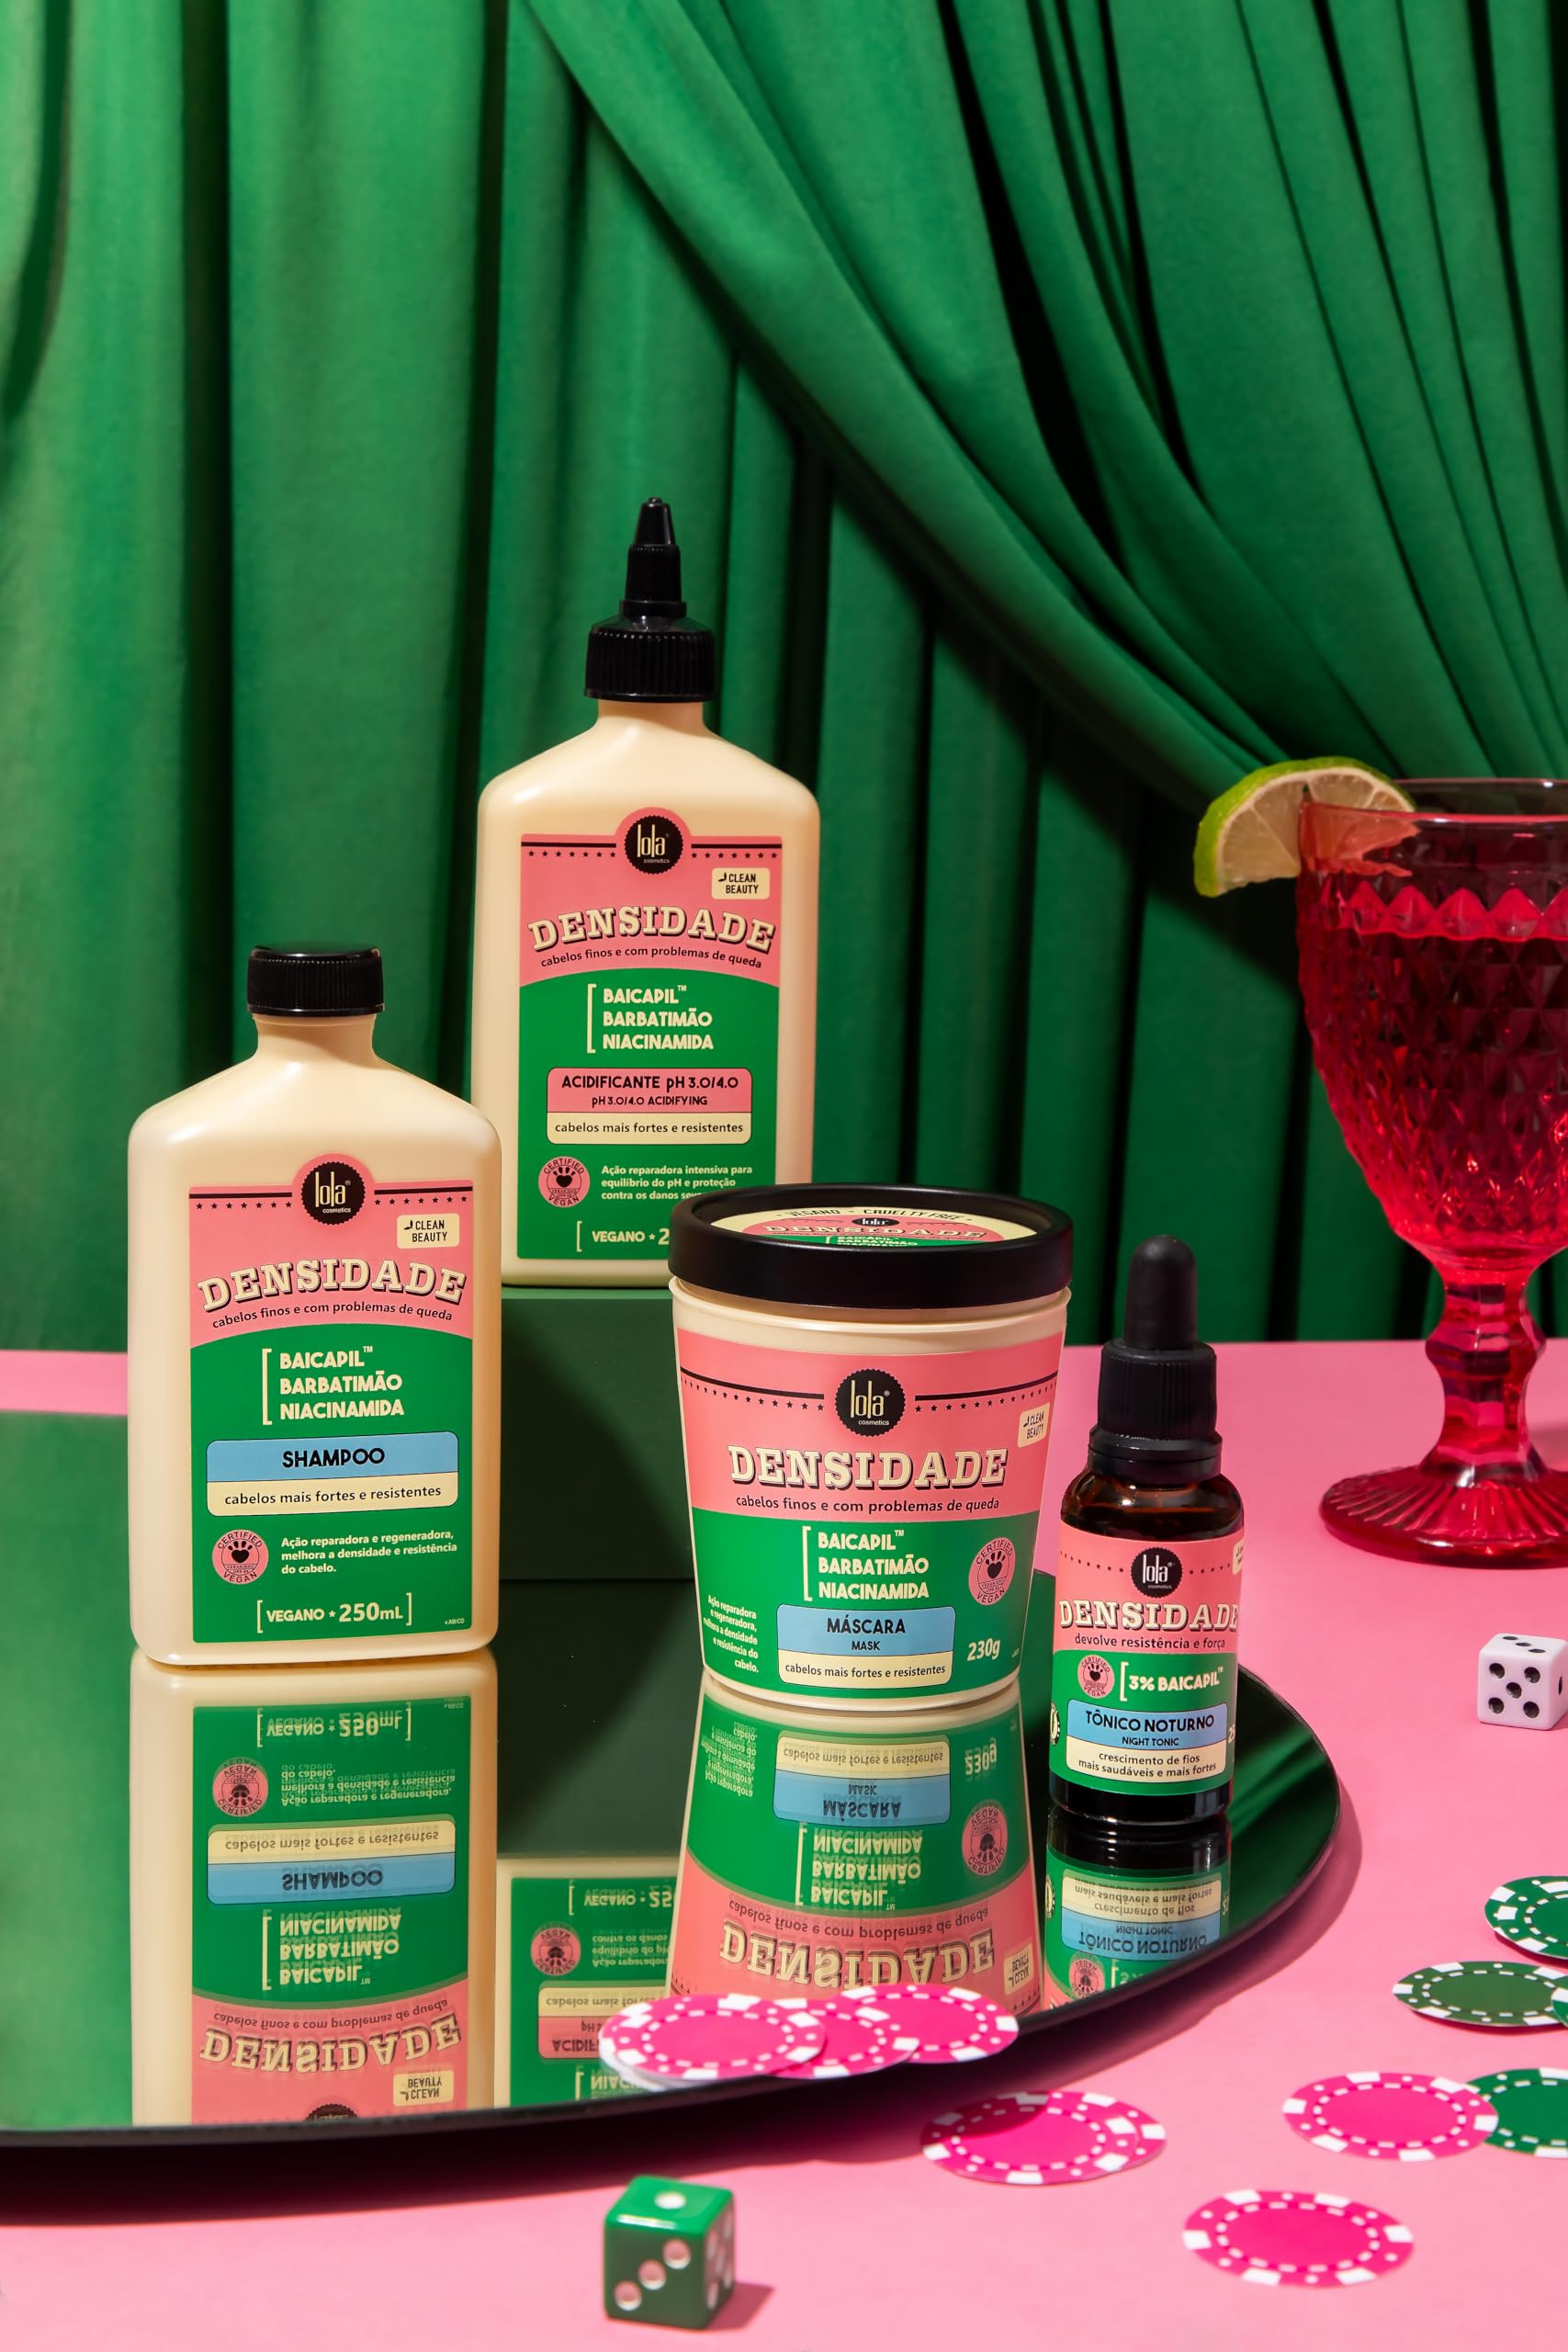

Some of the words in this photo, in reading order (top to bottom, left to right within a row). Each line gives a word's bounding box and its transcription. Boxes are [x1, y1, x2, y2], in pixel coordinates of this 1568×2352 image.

[728, 873, 756, 883] CLEAN
[725, 884, 759, 894] BEAUTY
[527, 905, 776, 955] DENSIDADE
[541, 951, 582, 967] cabelos
[584, 947, 613, 960] finos
[625, 947, 648, 956] com
[650, 945, 709, 960] problemas
[712, 950, 726, 961] de
[728, 954, 762, 969] queda
[603, 1008, 713, 1027] BARBATIMÃO
[603, 1035, 714, 1050] NIACINAMIDA
[561, 1075, 660, 1089] ACIDIFICANTE
[666, 1076, 685, 1093] pH
[688, 1076, 739, 1090] 3.0/4.0
[592, 1096, 605, 1108] pH
[608, 1096, 645, 1106] 3.0/4.0
[648, 1096, 708, 1106] ACIDIFYING
[555, 1121, 599, 1133] cabelos
[603, 1122, 630, 1133] mais
[633, 1122, 669, 1133] fortes
[671, 1125, 679, 1133] e
[682, 1122, 744, 1133] resistentes
[543, 1158, 584, 1175] CERTIFIED
[602, 1165, 626, 1176] Ação
[628, 1166, 682, 1176] reparadora
[685, 1165, 728, 1174] intensiva
[730, 1167, 752, 1177] para
[602, 1178, 649, 1188] equilíbrio
[651, 1178, 665, 1187] do
[667, 1179, 682, 1189] pH
[693, 1177, 736, 1189] proteção
[548, 1195, 580, 1206] VEGAN
[602, 1192, 633, 1200] contra
[649, 1192, 679, 1200] danos
[863, 1209, 926, 1217] CRUELTY
[928, 1212, 964, 1221] FREE
[415, 1218, 445, 1231] CLEAN
[762, 1226, 987, 1238] DENSIDADE
[412, 1231, 447, 1243] BEAUTY
[592, 1230, 645, 1242] VEGANO
[197, 1258, 467, 1313] DENSIDADE
[212, 1310, 257, 1329] cabelos
[260, 1306, 290, 1317] finos
[303, 1304, 330, 1313] com
[333, 1301, 396, 1315] problemas
[399, 1304, 413, 1315] de
[416, 1306, 453, 1323] queda
[279, 1370, 402, 1395] BARBATIMÃO
[279, 1399, 405, 1420] NIACINAMIDA
[1030, 1411, 1044, 1425] CLEAN
[1026, 1422, 1044, 1440] BEAUTY
[282, 1447, 385, 1468] SHAMPOO
[728, 1444, 1009, 1490] DENSIDADE
[224, 1491, 276, 1505] cabelos
[279, 1491, 311, 1503] mais
[315, 1488, 355, 1502] fortes
[359, 1492, 367, 1500] e
[370, 1486, 442, 1499] resistentes
[736, 1495, 780, 1510] cabelos
[783, 1498, 817, 1510] finos
[821, 1502, 829, 1511] e
[833, 1502, 863, 1512] com
[868, 1499, 943, 1515] problemas
[946, 1498, 963, 1510] de
[965, 1497, 999, 1514] queda
[217, 1532, 263, 1549] CERTIFIED
[281, 1535, 309, 1551] Ação
[310, 1533, 369, 1548] reparadora
[371, 1535, 379, 1544] e
[380, 1530, 455, 1545] regeneradora,
[281, 1549, 326, 1562] melhora
[337, 1545, 391, 1559] densidade
[394, 1547, 400, 1555] e
[402, 1542, 457, 1555] resistência
[976, 1540, 1013, 1565] CERTIFIED
[281, 1564, 296, 1575] do
[299, 1563, 337, 1574] cabelo.
[818, 1555, 929, 1576] BARBATIMÃO
[223, 1571, 257, 1583] VEGAN
[818, 1581, 930, 1600] NIACINAMIDA
[976, 1587, 1005, 1603] VEGAN
[266, 1609, 325, 1623] VEGANO
[338, 1602, 403, 1623] 250mL
[720, 1601, 757, 1619] reparadora
[1059, 1600, 1238, 1633] DENSIDADE
[714, 1611, 757, 1633] regeneradora,
[827, 1613, 907, 1634] MÁSCARA
[724, 1627, 758, 1645] densidade
[1075, 1634, 1118, 1647] devolve
[1122, 1636, 1190, 1649] resistência
[1193, 1640, 1200, 1648] e
[1202, 1638, 1225, 1651] força
[748, 1648, 759, 1659] do
[852, 1640, 881, 1652] MASK
[967, 1638, 1000, 1661] 230g
[734, 1658, 760, 1673] cabelo.
[785, 1663, 822, 1676] cabelos
[825, 1668, 849, 1678] mais
[852, 1667, 883, 1679] fortes
[885, 1669, 892, 1678] e
[894, 1665, 946, 1678] resistentes
[1129, 1676, 1155, 1690] 3%
[1086, 1709, 1141, 1731] TÔNICO
[1145, 1714, 1214, 1732] NOTURNO
[1122, 1736, 1150, 1747] NIGHT
[1152, 1737, 1179, 1747] TONIC
[1099, 1751, 1164, 1766] crescimento
[1167, 1755, 1180, 1765] de
[1182, 1754, 1201, 1765] fios
[1078, 1758, 1100, 1771] mais
[1101, 1762, 1155, 1778] saudáveis
[1166, 1766, 1190, 1777] mais
[1192, 1762, 1217, 1775] fortes
